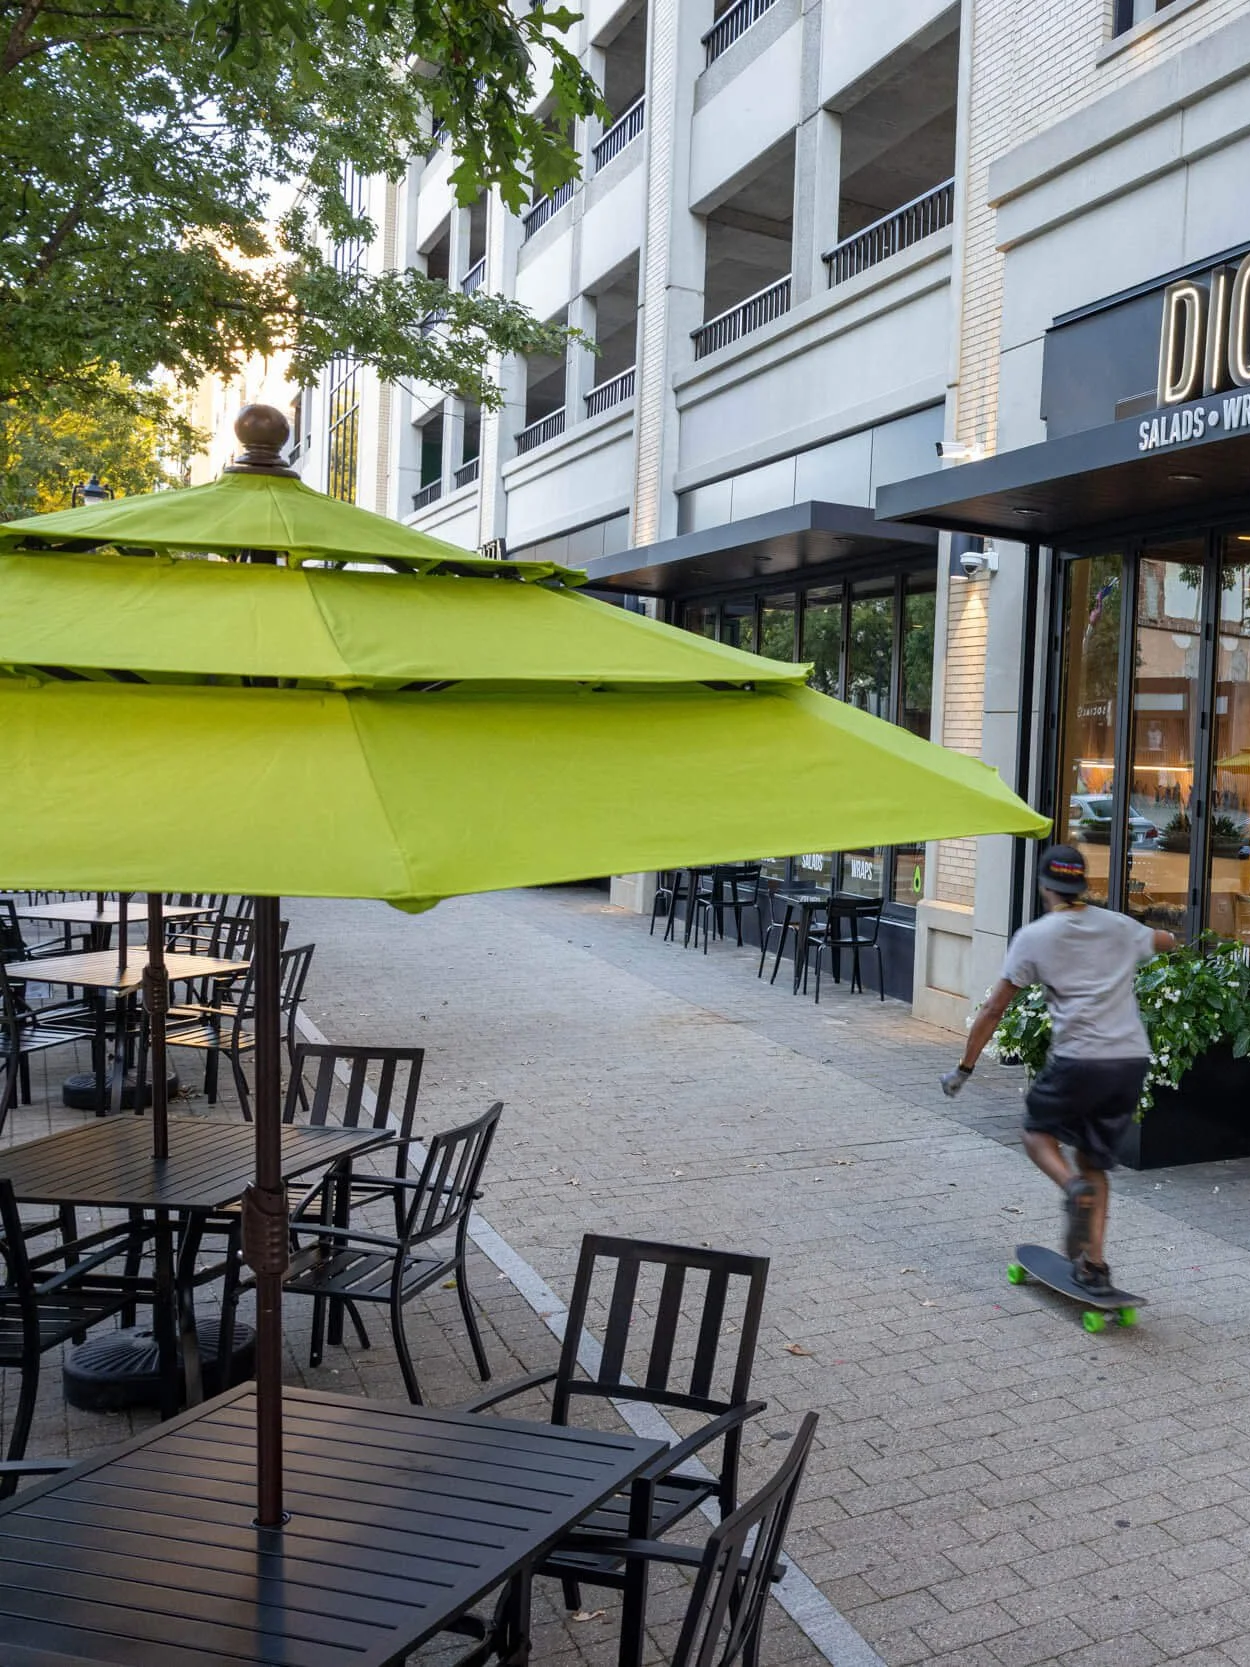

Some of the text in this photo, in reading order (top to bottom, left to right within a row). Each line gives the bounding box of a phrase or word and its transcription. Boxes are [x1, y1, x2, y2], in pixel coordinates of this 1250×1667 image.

[1138, 407, 1205, 451] SALADS
[801, 853, 823, 872] SALADS
[851, 858, 873, 880] WRAPS
